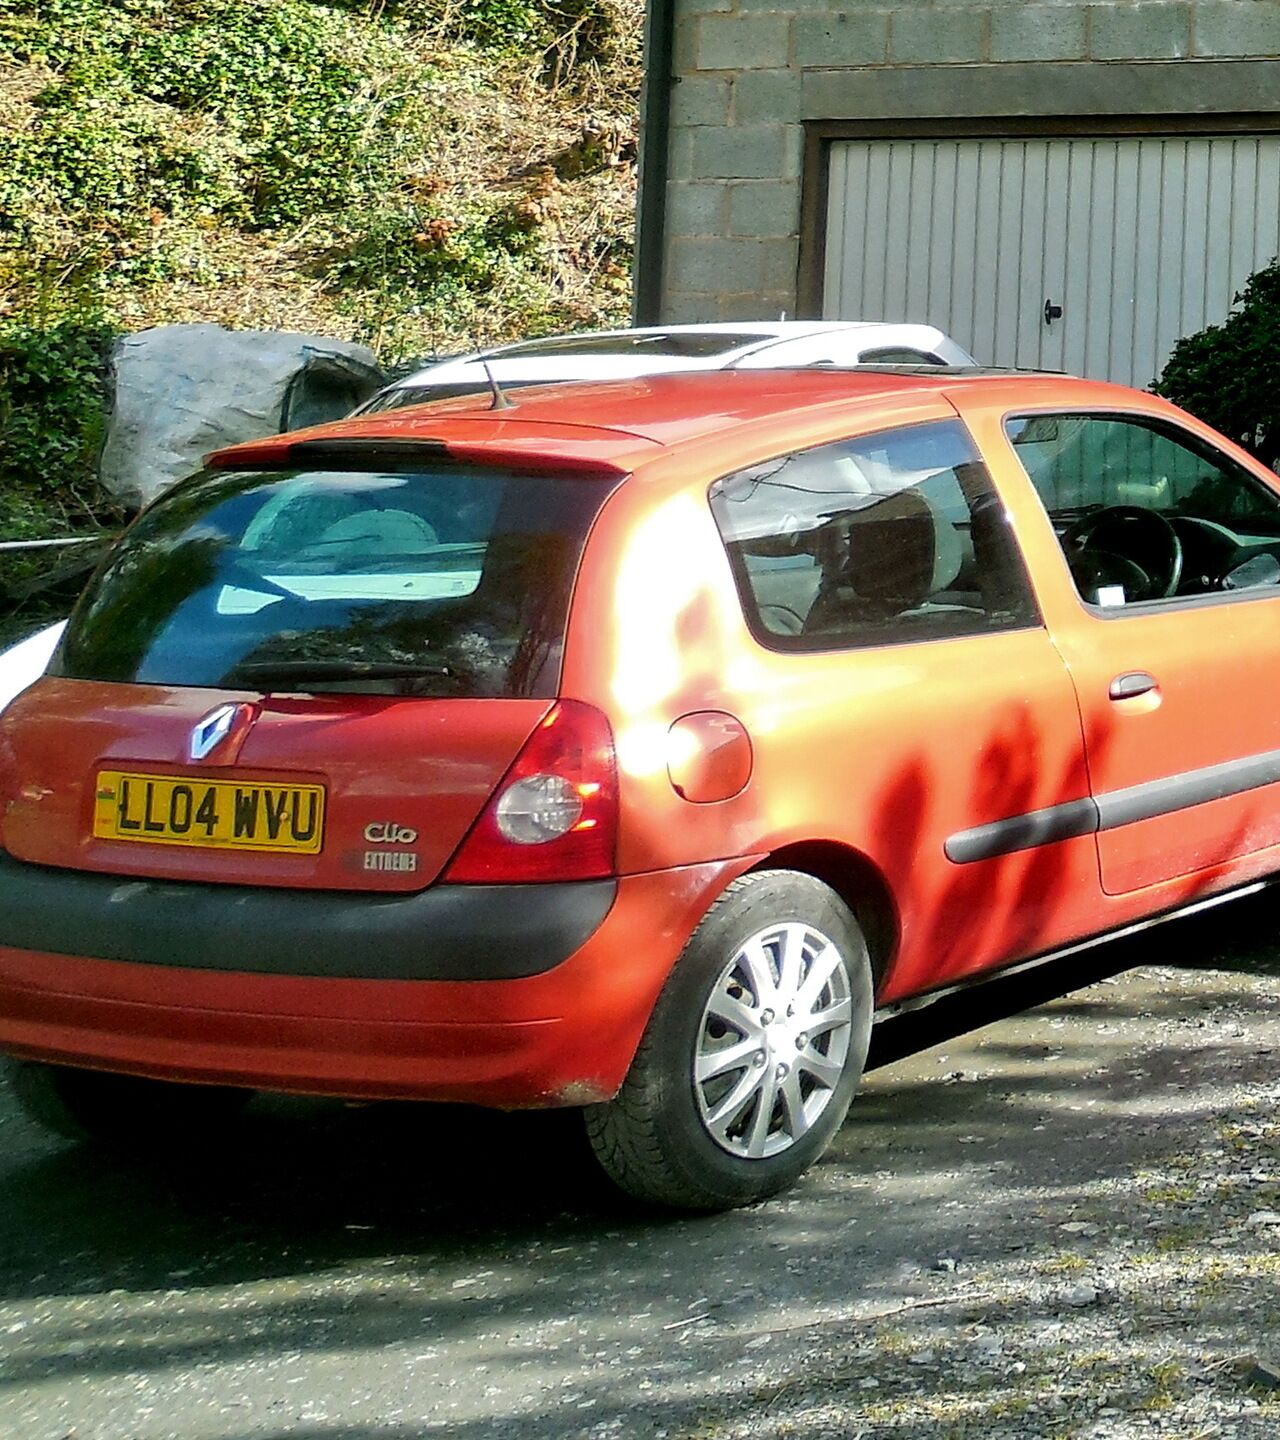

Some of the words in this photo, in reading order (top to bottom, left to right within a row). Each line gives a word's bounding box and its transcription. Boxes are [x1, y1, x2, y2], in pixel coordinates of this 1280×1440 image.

[118, 780, 220, 836] LL04
[233, 788, 318, 841] WVU
[364, 822, 417, 844] Clio
